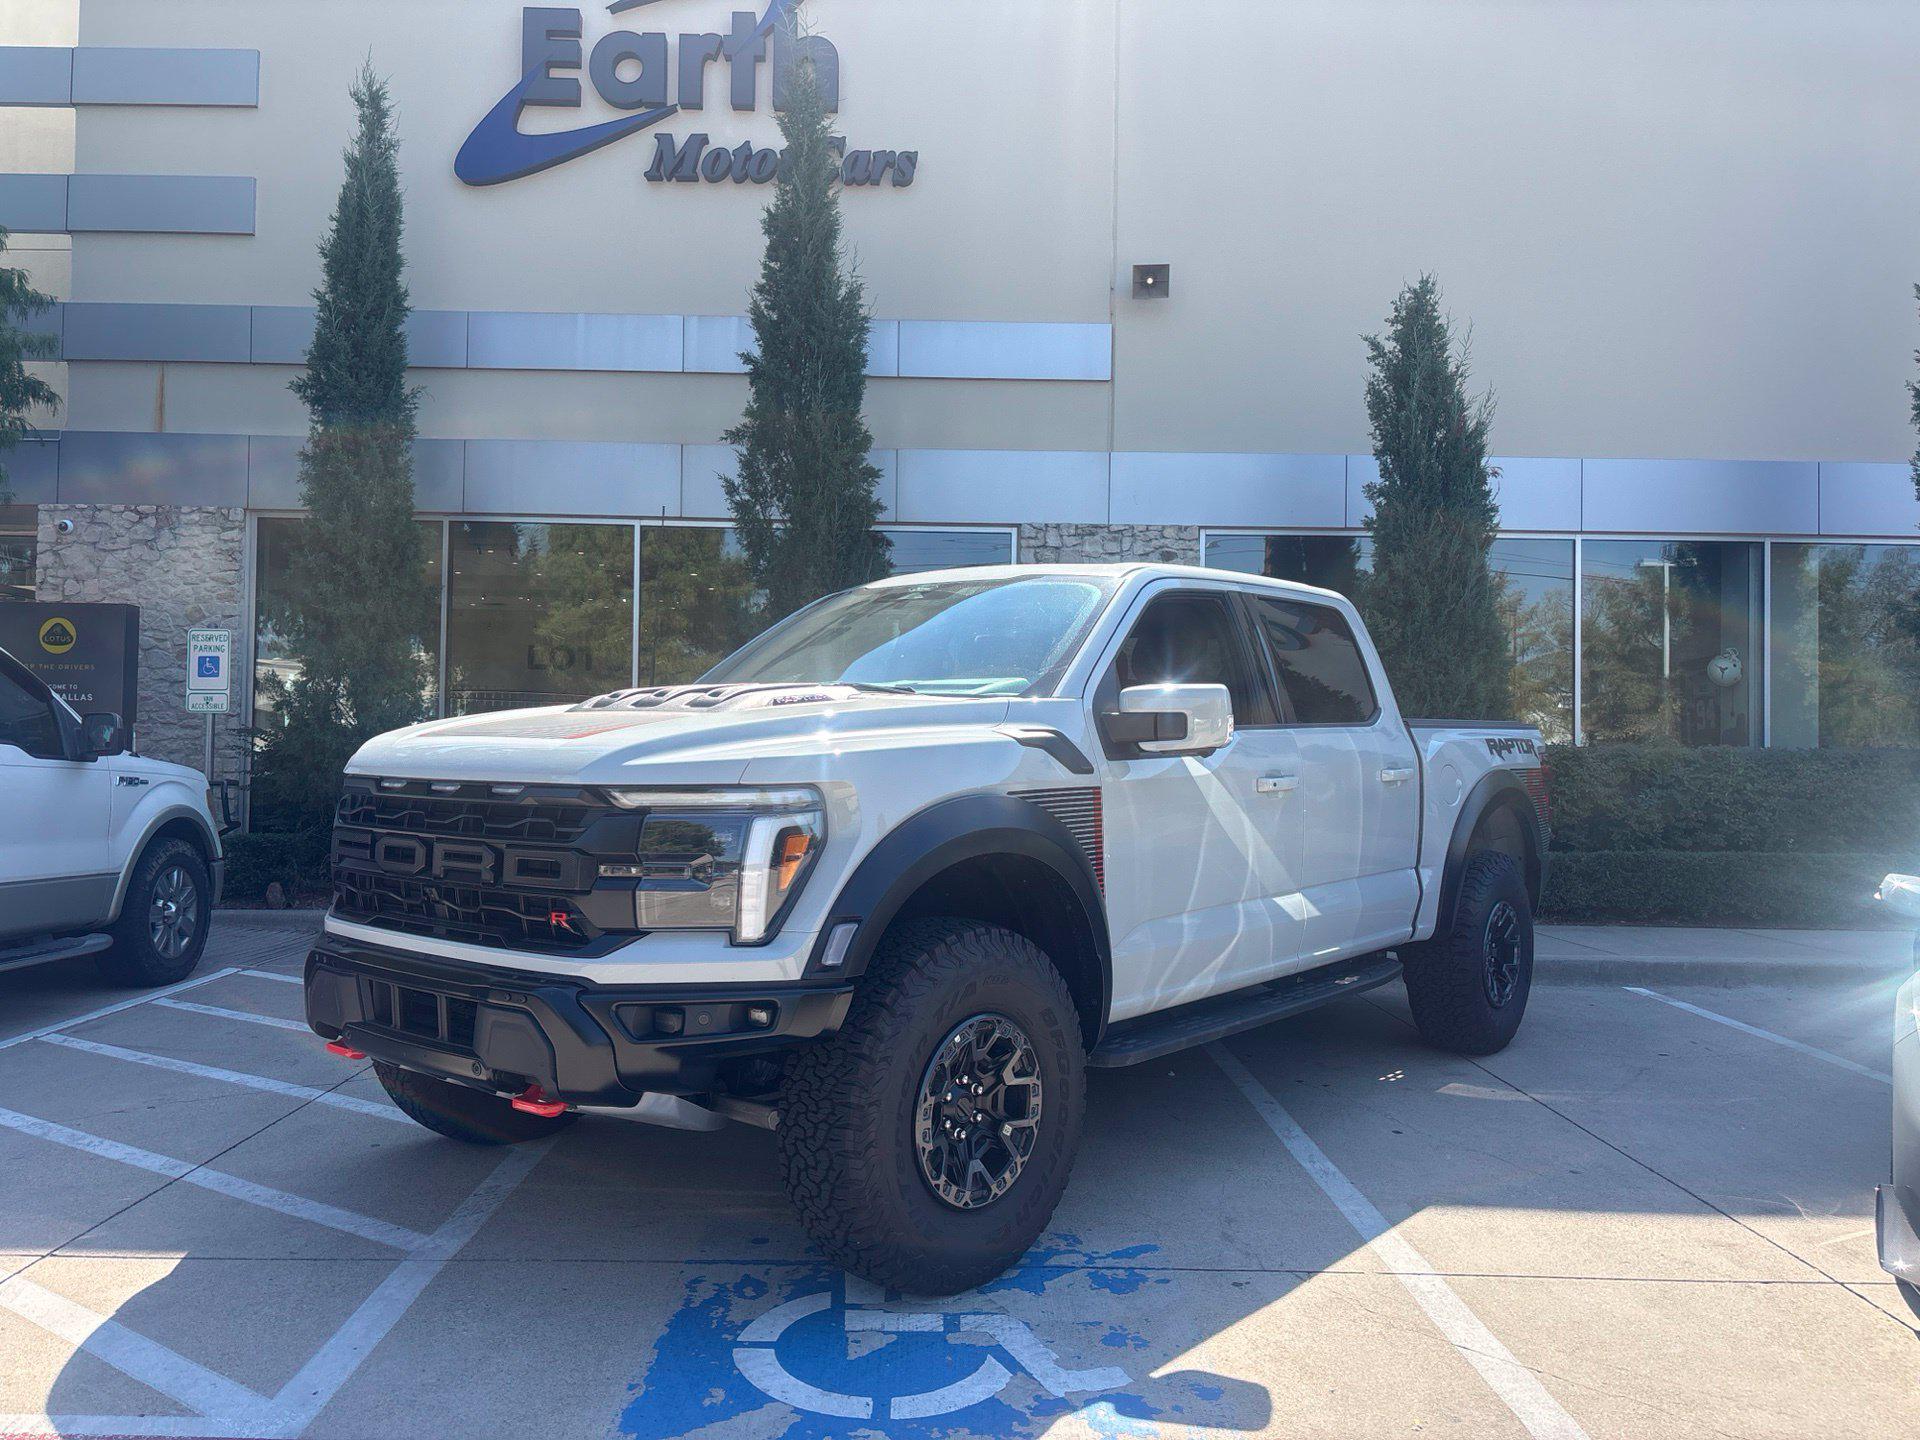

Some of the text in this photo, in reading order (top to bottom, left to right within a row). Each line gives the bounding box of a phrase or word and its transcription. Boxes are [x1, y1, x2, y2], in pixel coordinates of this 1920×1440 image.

[522, 6, 839, 114] Earth
[44, 635, 72, 643] LOTUS
[191, 633, 228, 643] RESERVED
[193, 644, 226, 653] PARKING
[59, 663, 96, 671] DRIVERS
[59, 693, 93, 701] ALLAS
[191, 702, 225, 710] ACCESSIBLE
[1484, 737, 1540, 761] RAPTOR
[332, 828, 588, 891] FORD
[551, 911, 573, 931] R
